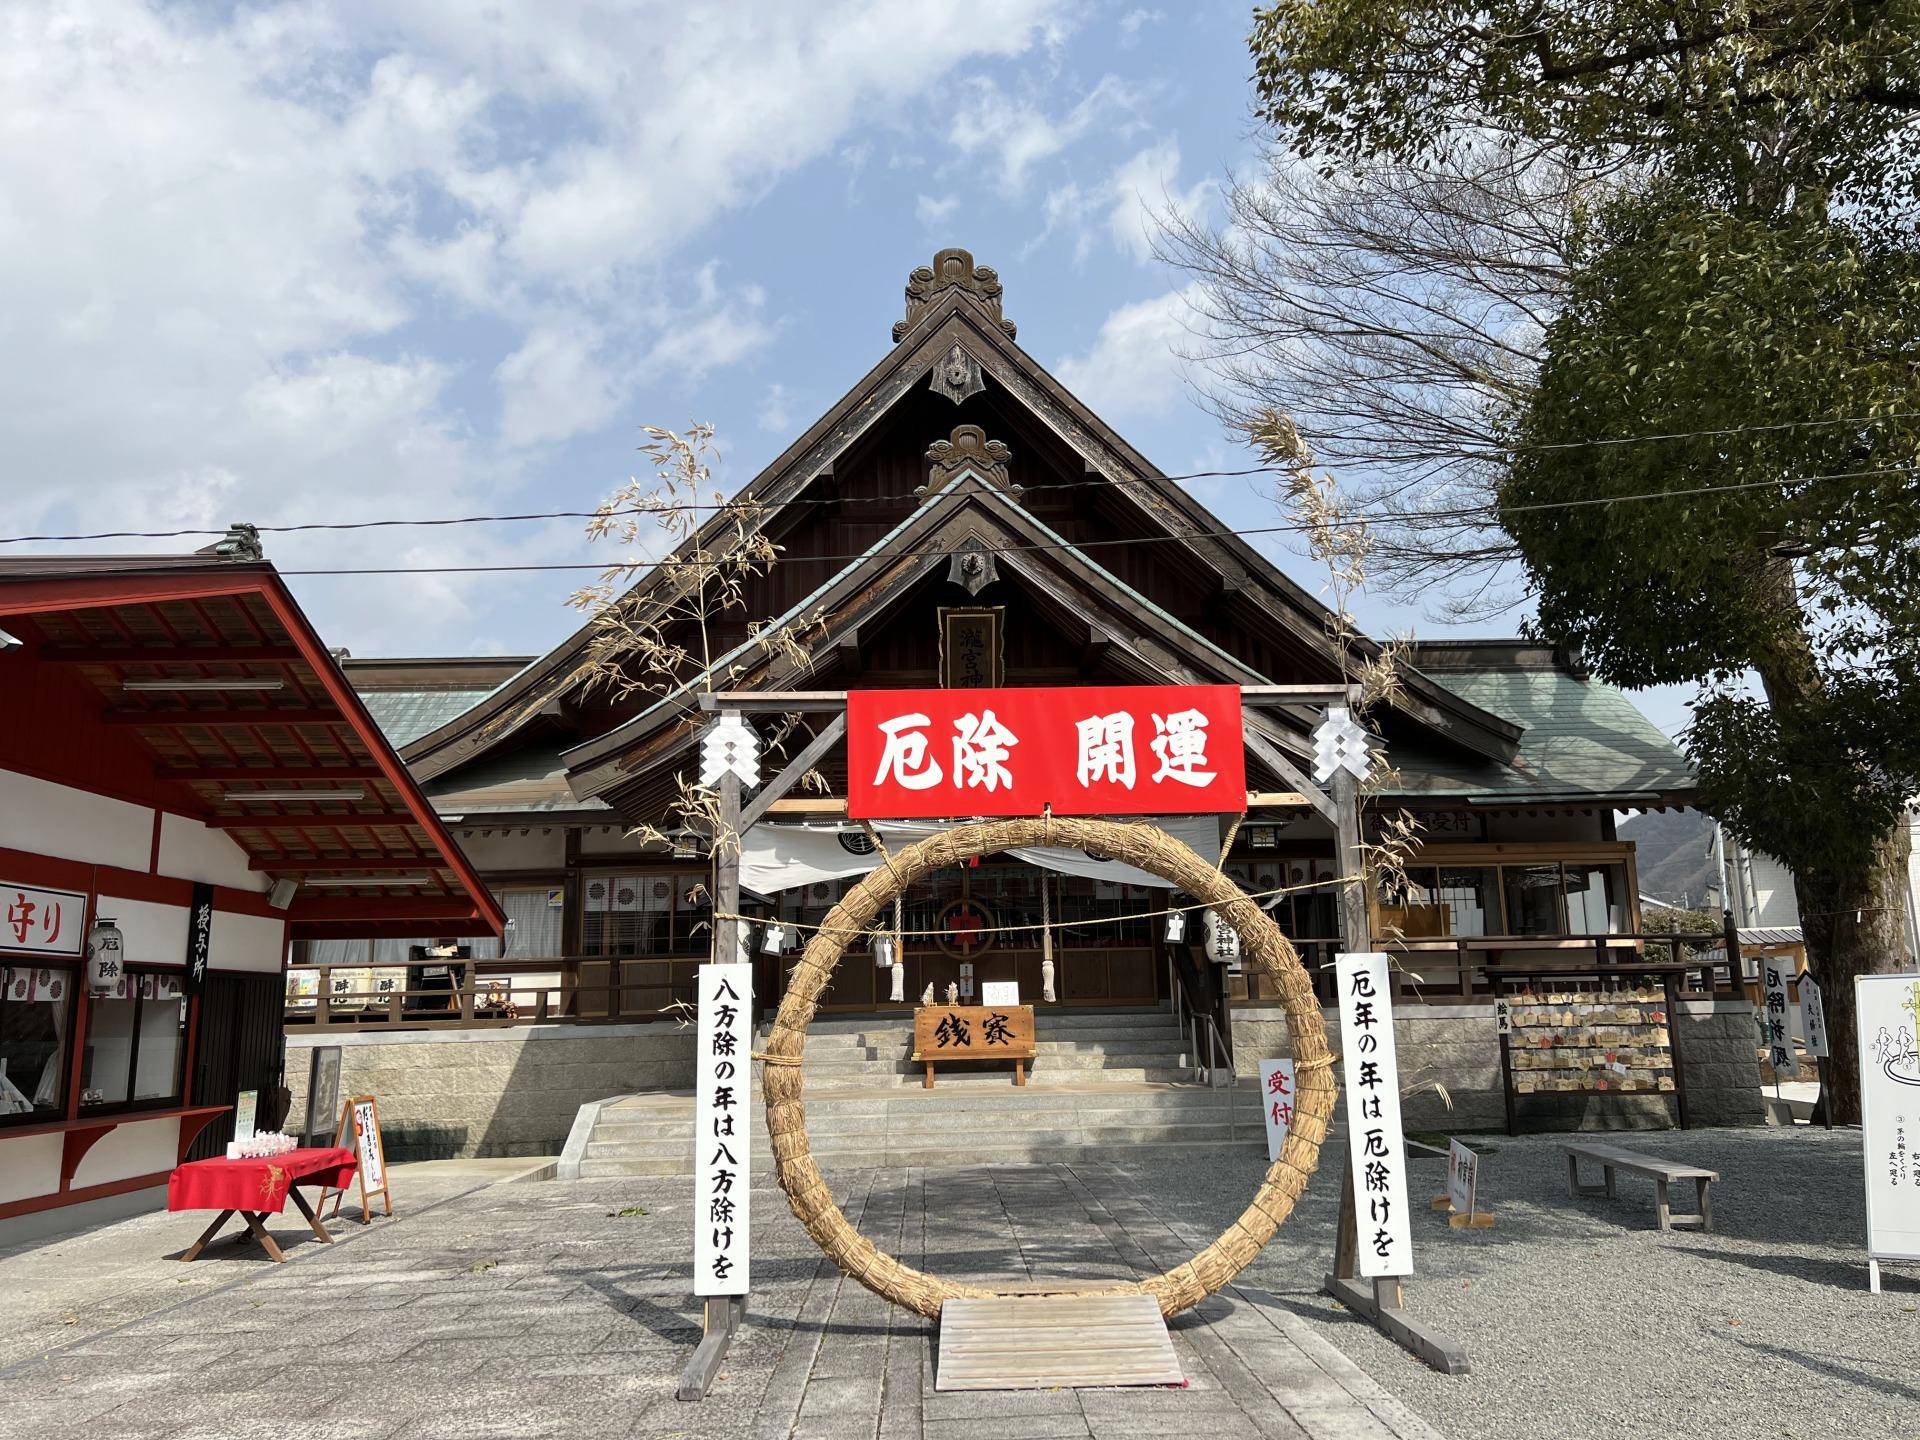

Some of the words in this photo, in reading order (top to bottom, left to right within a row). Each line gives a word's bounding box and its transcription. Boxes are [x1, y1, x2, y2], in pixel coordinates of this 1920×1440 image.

[873, 709, 1019, 793] 厄除
[1075, 708, 1217, 790] 開運
[98, 937, 119, 979] 厄除
[192, 903, 211, 983] 授与所
[1496, 1002, 1509, 1031] 絵馬
[709, 978, 740, 1279] 八方除の年は八方除けを
[1268, 1070, 1294, 1126] 受付
[1350, 970, 1394, 1258] 厄年の年は厄除けを
